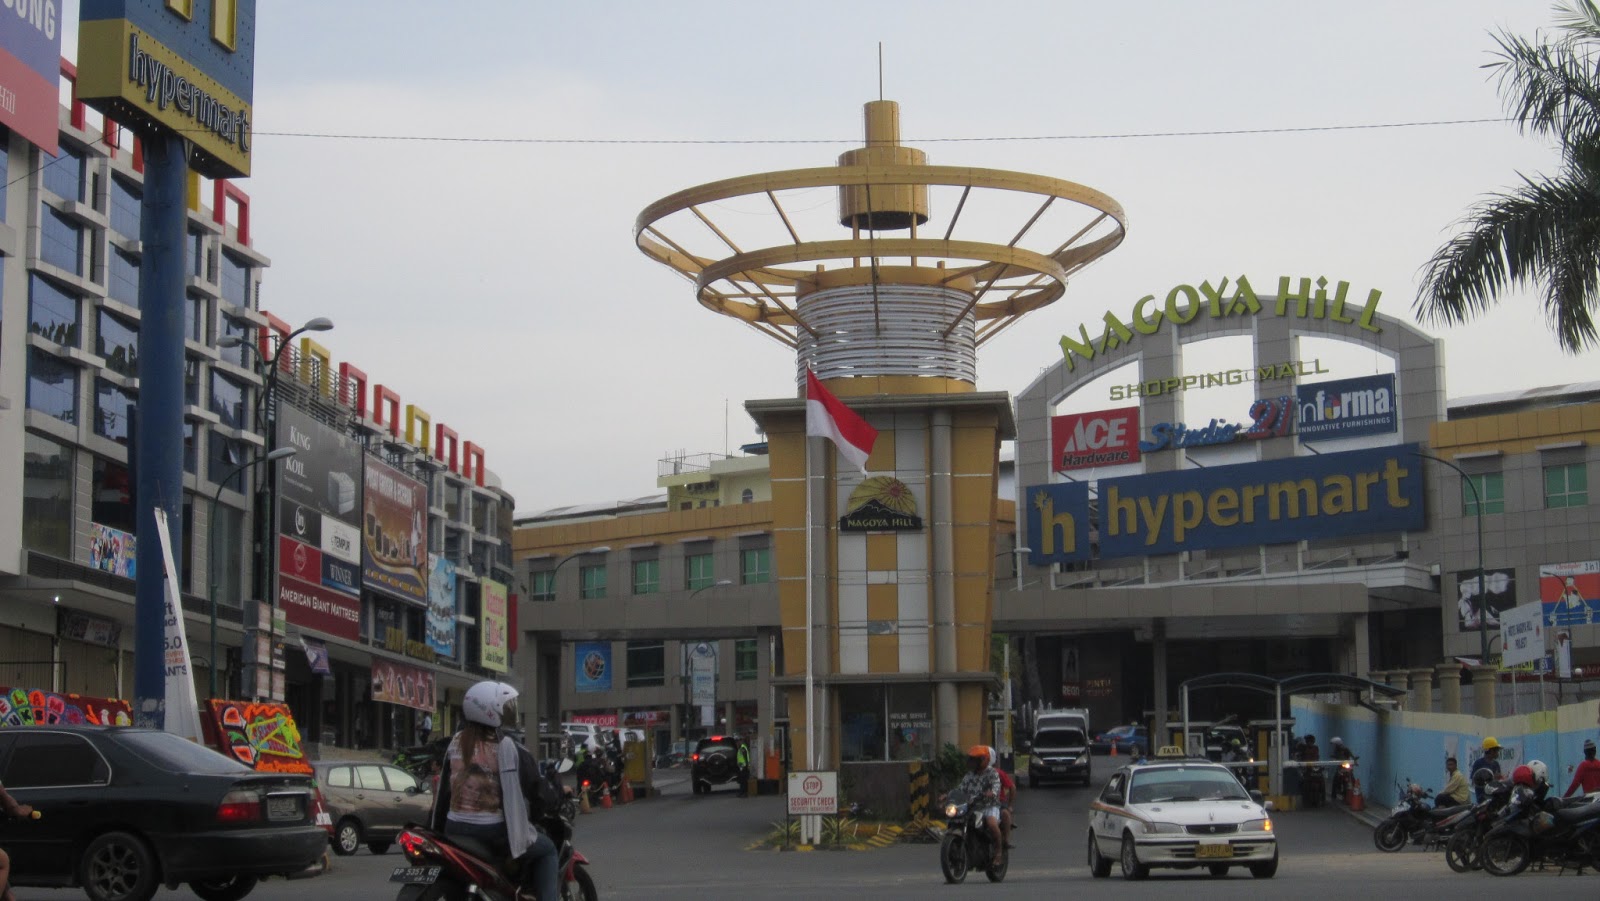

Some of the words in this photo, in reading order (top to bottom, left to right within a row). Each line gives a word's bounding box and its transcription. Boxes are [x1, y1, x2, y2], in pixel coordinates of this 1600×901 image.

[129, 33, 249, 152] hypermart
[1058, 274, 1262, 373] NAGOYA
[1109, 369, 1243, 401] SHOPPING
[1257, 359, 1330, 382] MALL
[1298, 387, 1390, 423] informa
[1064, 417, 1128, 452] ACE
[1139, 418, 1243, 453] Studio
[1247, 395, 1294, 439] 21
[1299, 422, 1340, 433] INNOVATIVE
[1342, 417, 1391, 428] FURNISHINGS
[290, 426, 311, 451] KING
[286, 456, 304, 478] KOIL
[1063, 451, 1129, 466] Hardware
[1108, 458, 1410, 546] hypermart
[330, 564, 352, 586] WINNER
[281, 586, 311, 608] AMERICAN
[312, 596, 330, 613] GIANT
[330, 603, 359, 622] MATTRESS
[585, 717, 616, 726] COLOUR
[806, 781, 819, 790] STOP
[791, 797, 816, 806] SECURITY
[817, 797, 835, 806] CHECK
[393, 868, 405, 876] BP
